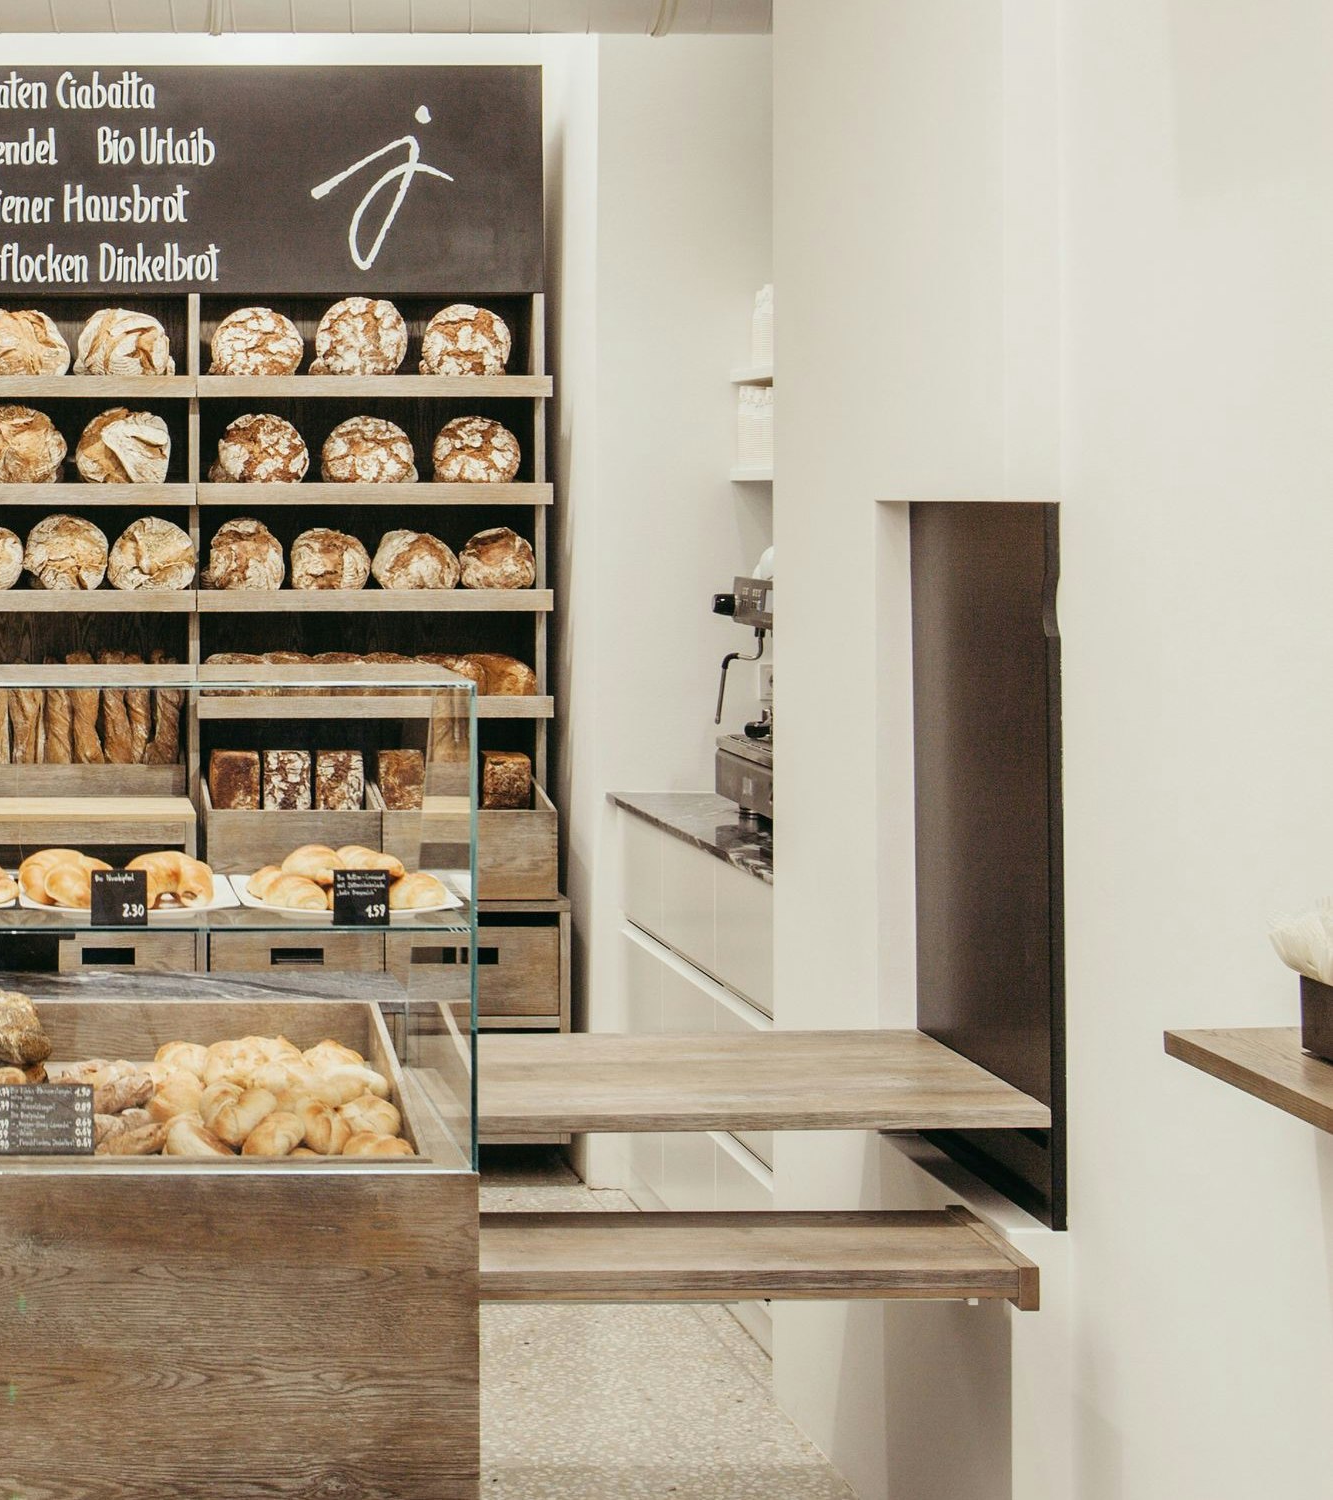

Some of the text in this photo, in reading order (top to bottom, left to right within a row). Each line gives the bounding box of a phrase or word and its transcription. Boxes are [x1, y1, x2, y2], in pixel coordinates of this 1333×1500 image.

[56, 71, 155, 109] Ciabatta
[98, 126, 215, 166] Bio Urlaib
[64, 184, 189, 223] Hausbrot
[100, 243, 220, 282] Dinkelbrot
[122, 903, 144, 917] 2.30
